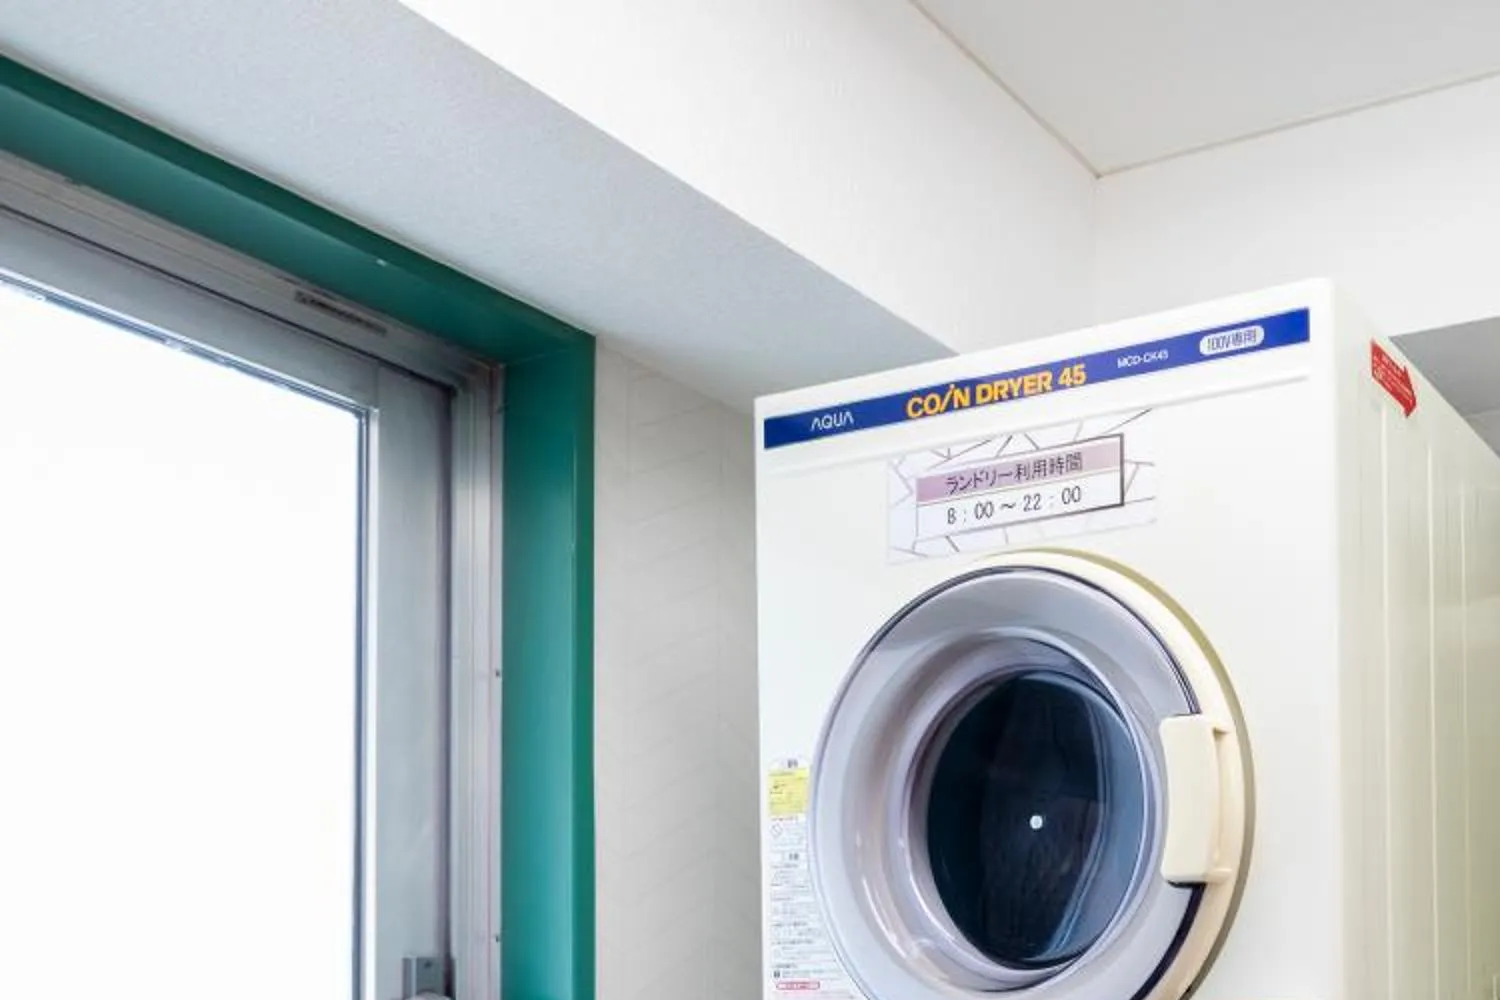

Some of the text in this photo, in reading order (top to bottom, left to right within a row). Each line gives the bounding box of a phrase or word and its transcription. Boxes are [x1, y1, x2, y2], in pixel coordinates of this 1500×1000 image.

[976, 370, 1053, 405] DRYER
[1058, 363, 1088, 388] 45
[810, 410, 855, 432] AQUA
[944, 451, 1084, 495] ランドリー利用時間
